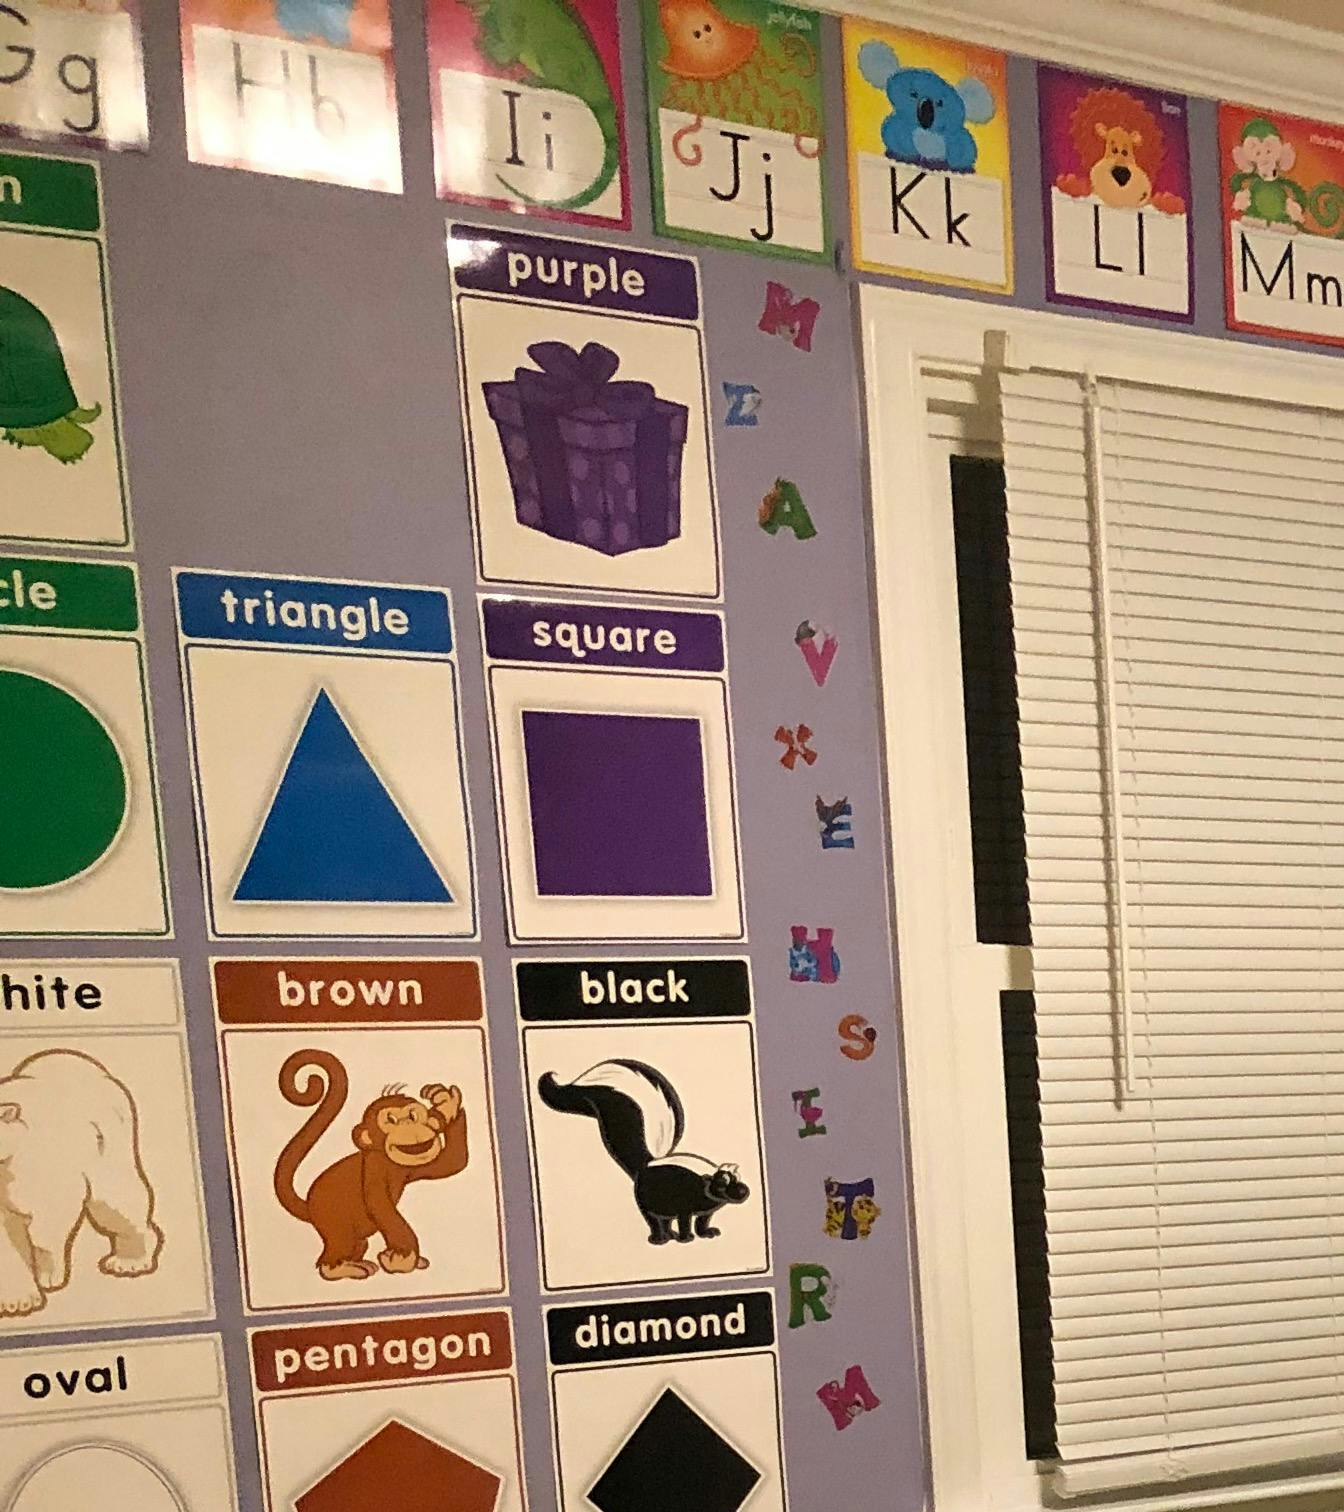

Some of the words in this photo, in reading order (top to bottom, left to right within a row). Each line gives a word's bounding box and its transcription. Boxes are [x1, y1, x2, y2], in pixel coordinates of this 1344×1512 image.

[502, 90, 555, 170] Ii
[709, 131, 775, 241] Jj
[890, 166, 971, 248] Kk
[1094, 204, 1145, 276] Ll
[507, 250, 646, 297] purple
[1241, 232, 1342, 307] Mm
[221, 590, 409, 641] triangle
[531, 617, 678, 658] square
[2, 974, 101, 1010] hite
[279, 971, 423, 1006] brown
[581, 971, 689, 1004] black
[574, 1304, 746, 1349] diamond
[23, 1356, 128, 1399] oval
[274, 1329, 491, 1384] pentagon
